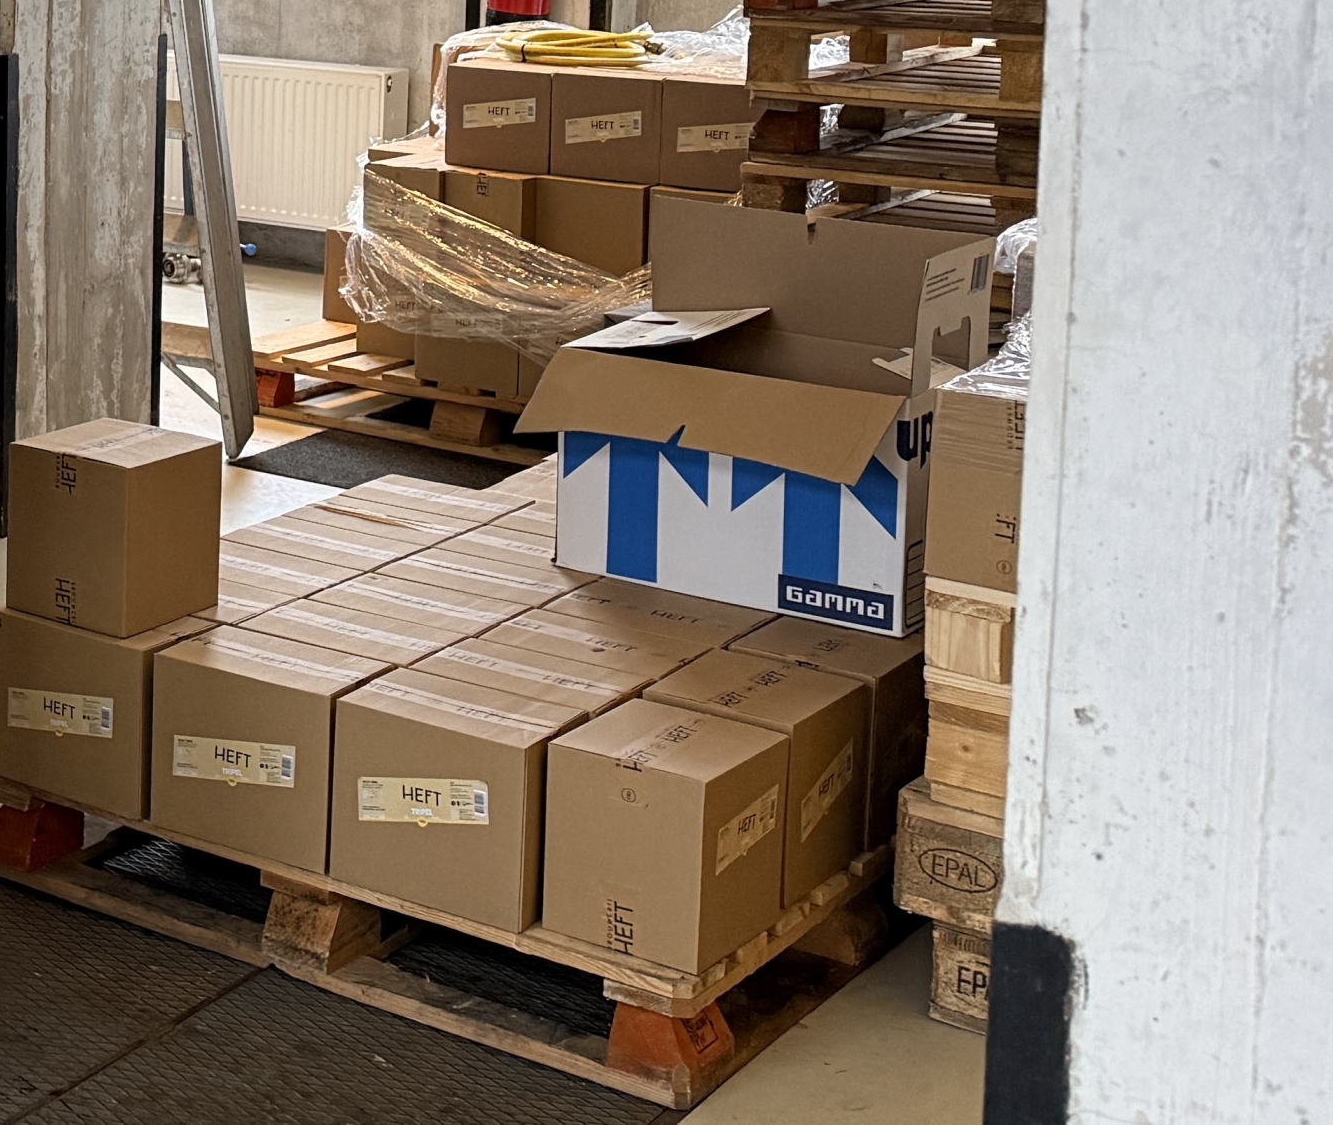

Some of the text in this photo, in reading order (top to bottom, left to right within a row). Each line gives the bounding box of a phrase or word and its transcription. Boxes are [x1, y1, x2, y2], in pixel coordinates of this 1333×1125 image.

[487, 106, 511, 117] HEFT
[591, 120, 615, 131] HEFT
[704, 129, 730, 141] HEFT
[994, 513, 1017, 544] FT
[43, 697, 76, 719] HEFT
[214, 745, 252, 768] HEFT
[402, 784, 442, 807] HEFT
[932, 853, 986, 888] EPAL
[613, 900, 634, 956] HEFT
[956, 965, 989, 999] EP
